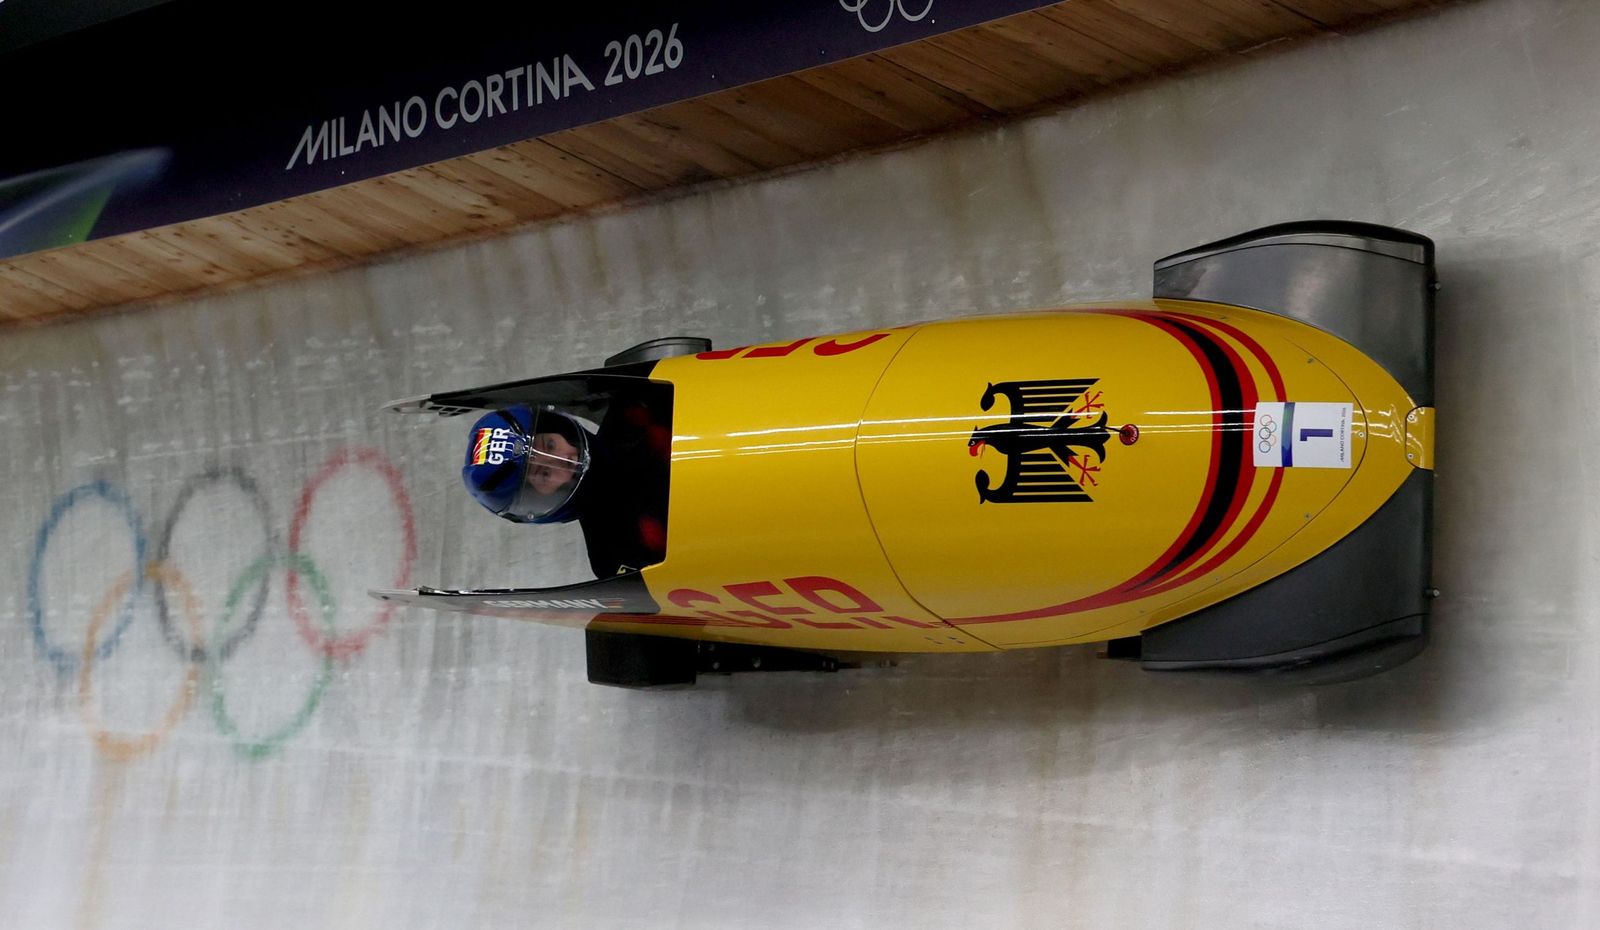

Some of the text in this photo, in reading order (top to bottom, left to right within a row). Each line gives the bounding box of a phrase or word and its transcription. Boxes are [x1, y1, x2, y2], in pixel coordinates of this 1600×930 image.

[285, 22, 684, 171] MILANO CORTINA 2026
[487, 427, 511, 465] GER
[1300, 428, 1333, 441] 1
